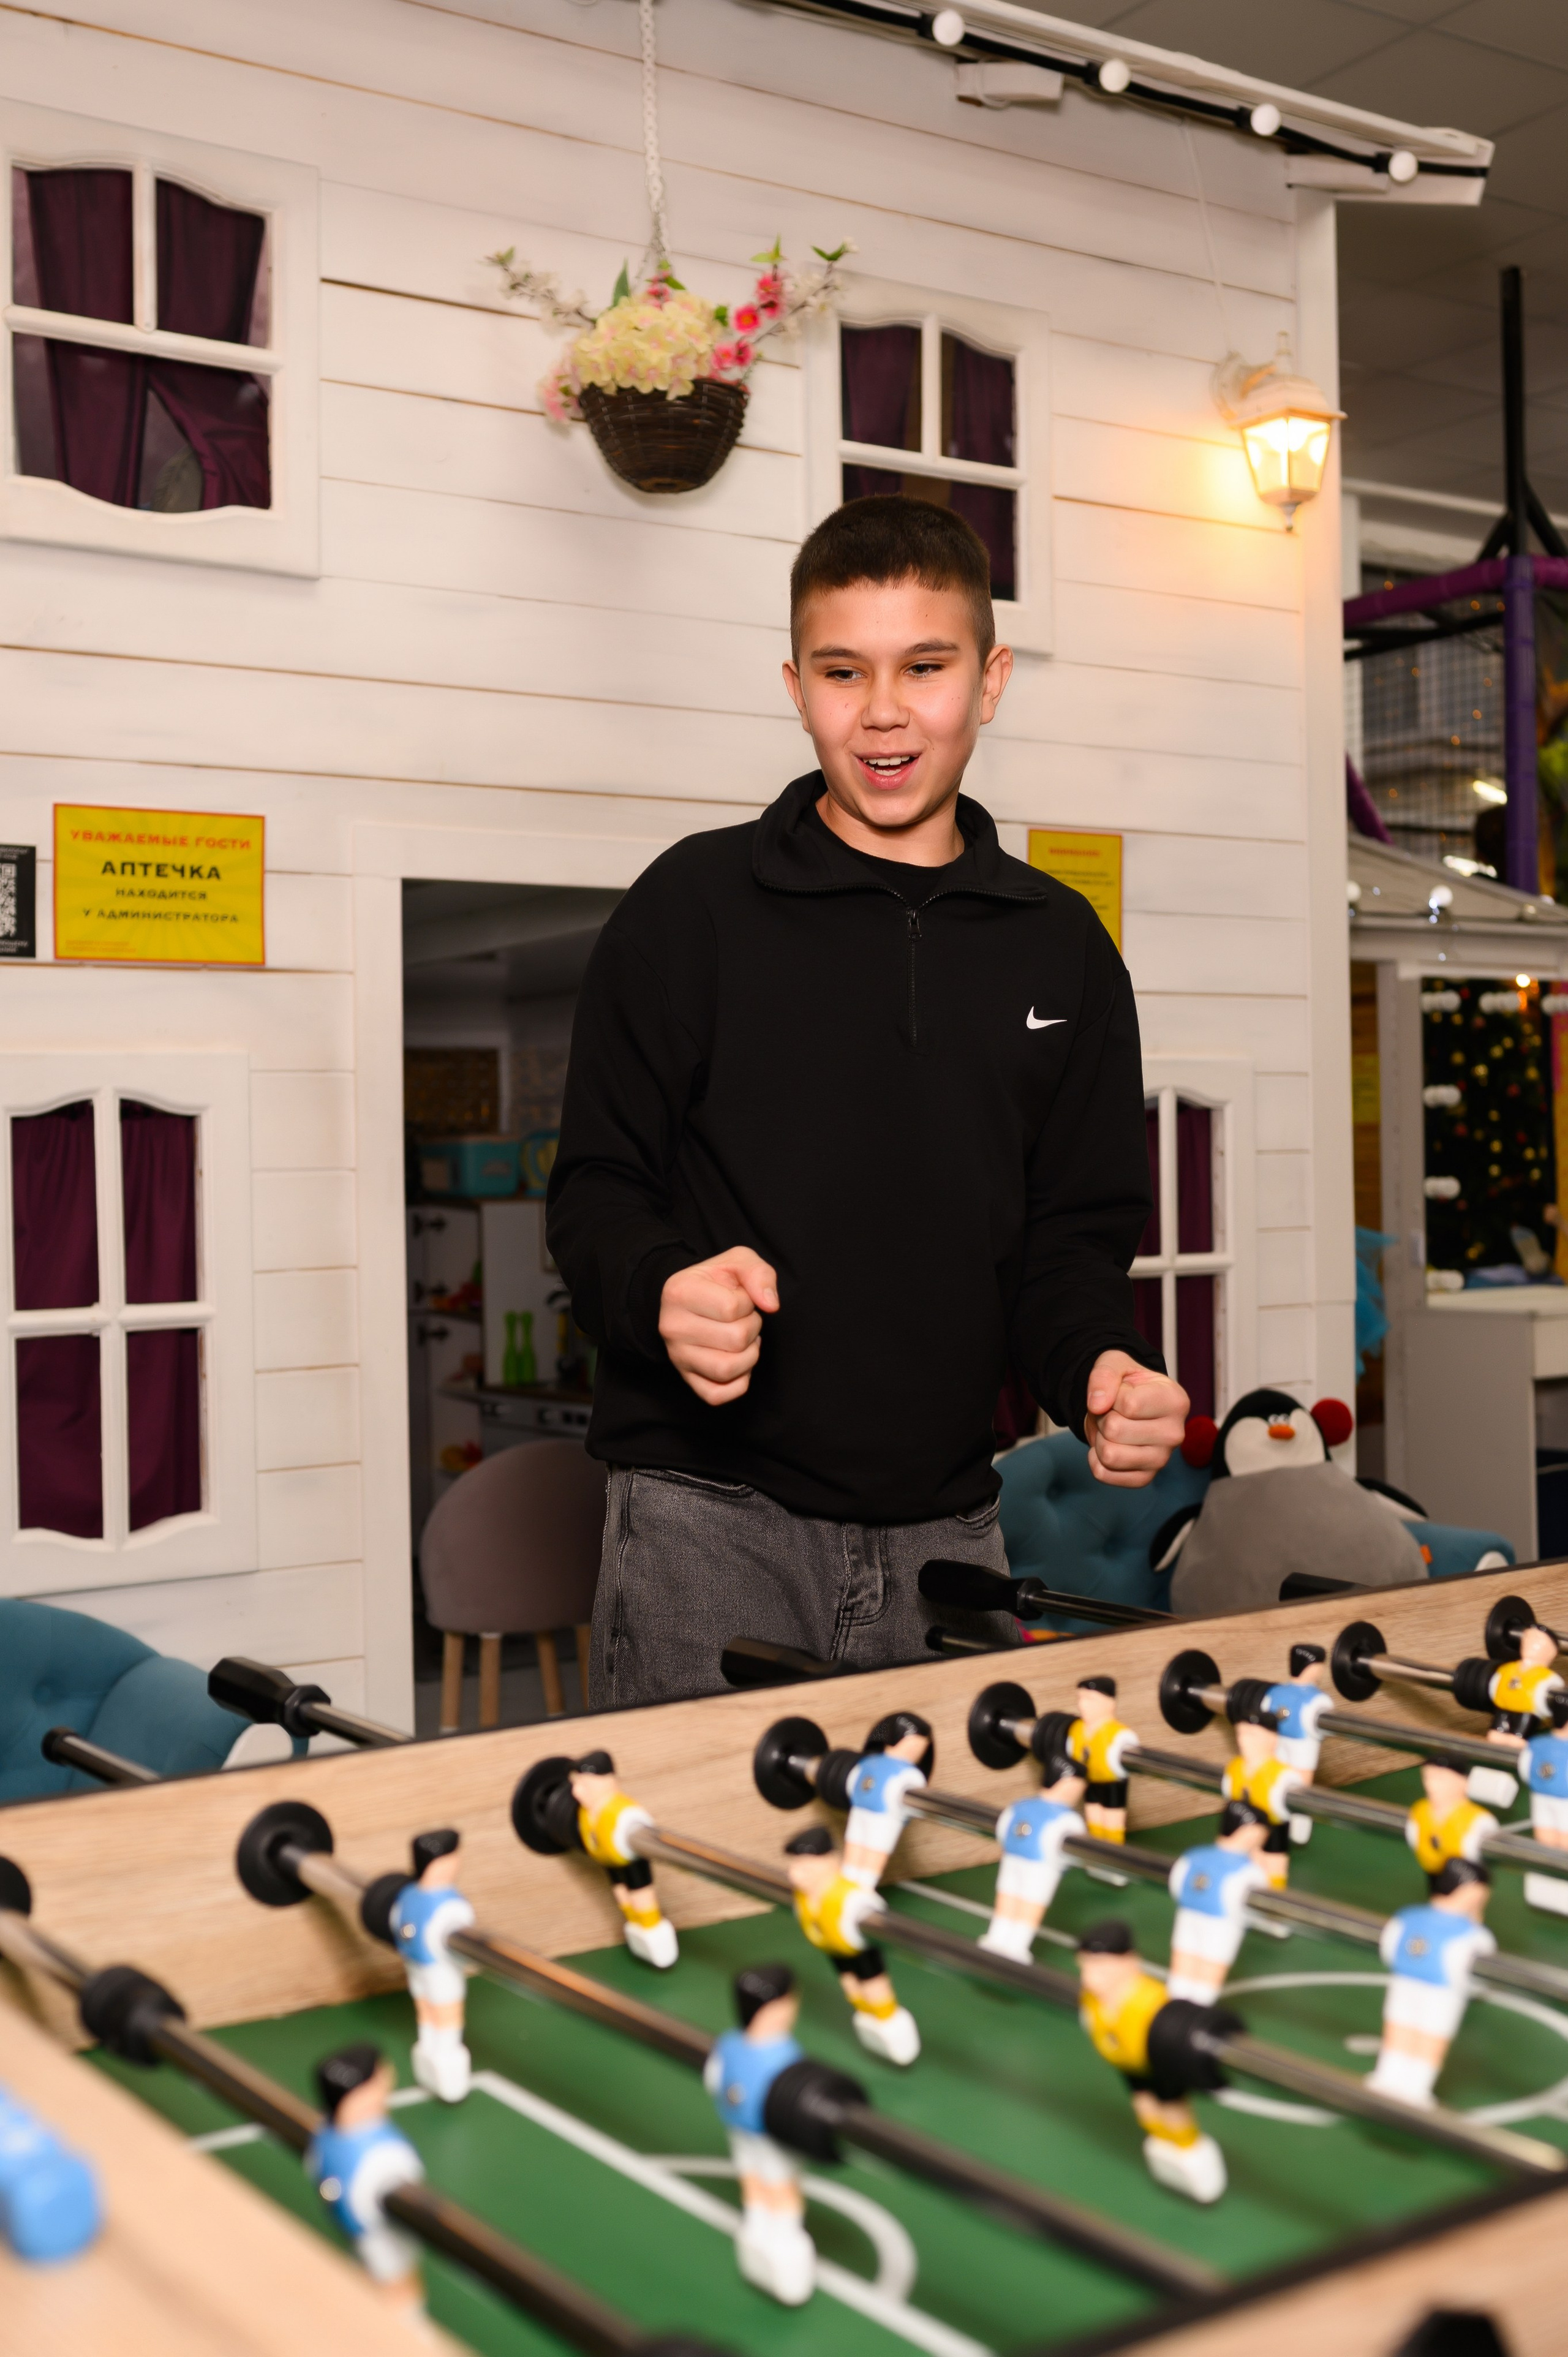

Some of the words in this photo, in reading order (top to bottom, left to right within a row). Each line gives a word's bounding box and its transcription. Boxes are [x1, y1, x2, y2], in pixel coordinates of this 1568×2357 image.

[70, 829, 189, 847] УВАЖАЕМЫЕ
[195, 837, 251, 849] ГОСТИ
[102, 861, 221, 880] АПТЕЧКА
[116, 888, 207, 900] НАХОДИТСЯ
[83, 908, 90, 918] У
[97, 910, 239, 923] АДМИНИСТРАТОРА
